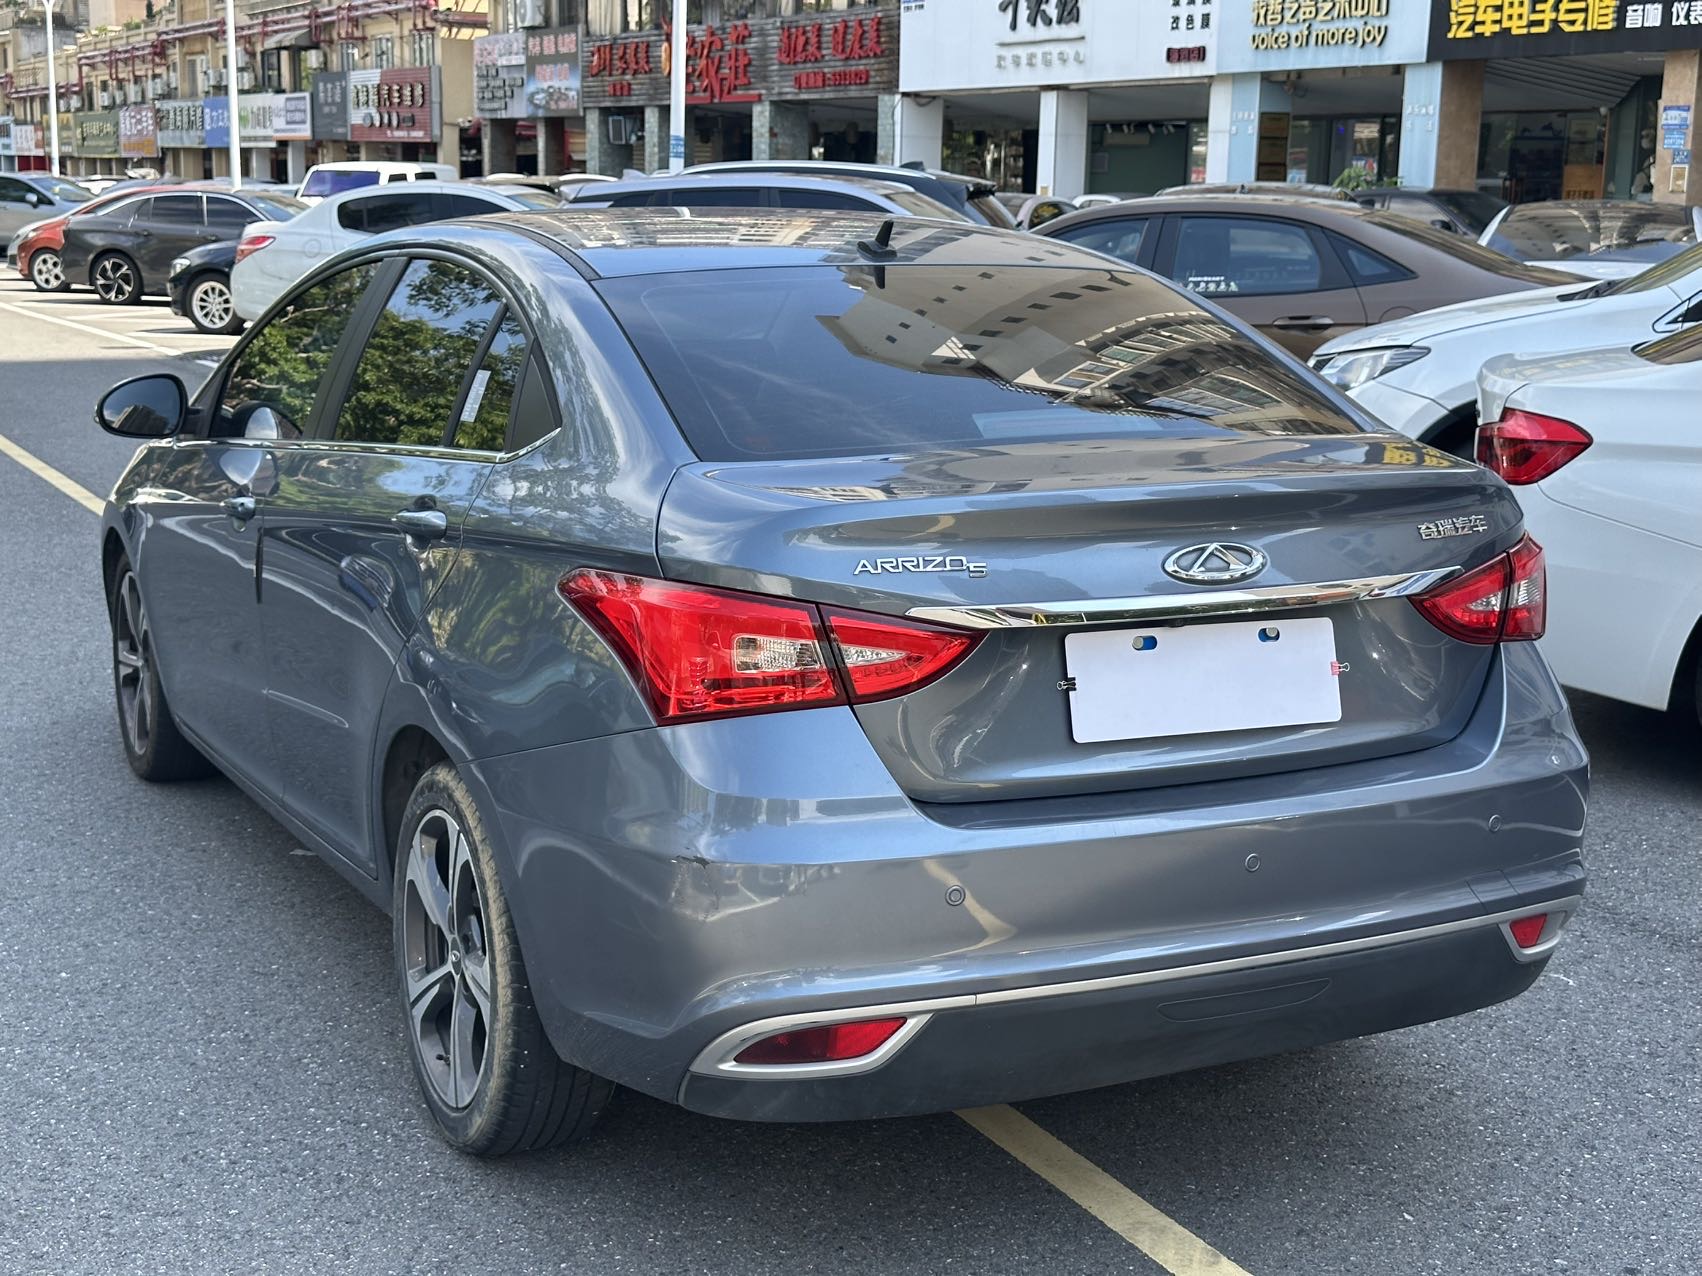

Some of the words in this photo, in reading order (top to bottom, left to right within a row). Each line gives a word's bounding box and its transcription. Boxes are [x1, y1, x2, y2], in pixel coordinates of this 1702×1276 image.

[1447, 0, 1619, 39] 汽车电子专修
[1625, 4, 1662, 28] 音响
[1251, 28, 1290, 49] voice
[1293, 22, 1311, 48] of
[1313, 26, 1357, 46] more
[1358, 21, 1388, 48] joy
[1418, 515, 1488, 540] 奇瑞汽车
